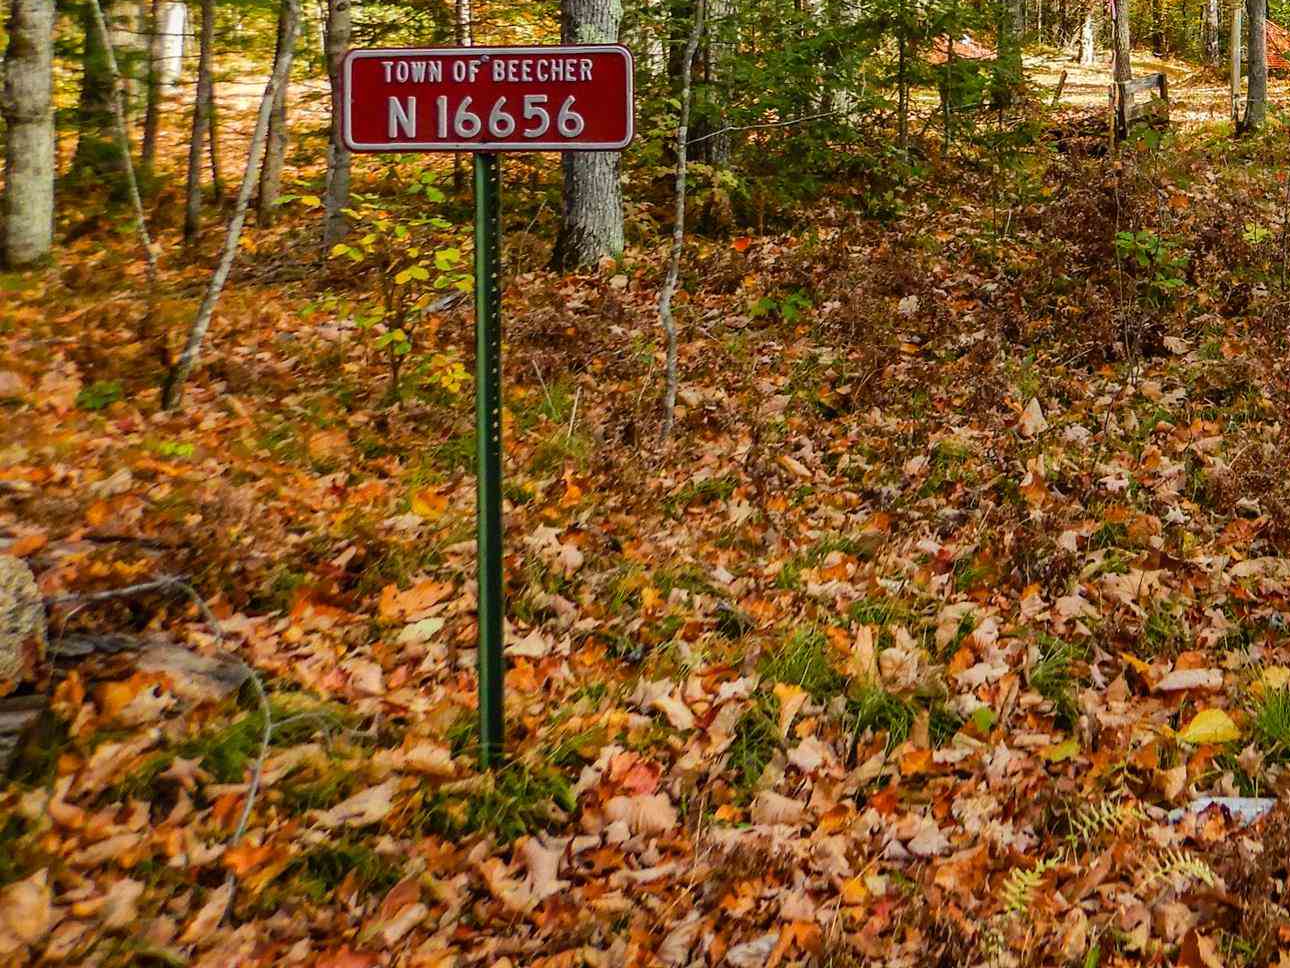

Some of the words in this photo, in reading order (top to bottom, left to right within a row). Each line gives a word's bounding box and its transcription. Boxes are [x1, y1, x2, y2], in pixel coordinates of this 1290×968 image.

[381, 60, 442, 83] TOWN
[453, 60, 481, 83] OF
[492, 58, 593, 82] BEECHER
[387, 95, 417, 138] N
[436, 94, 585, 138] 16656
